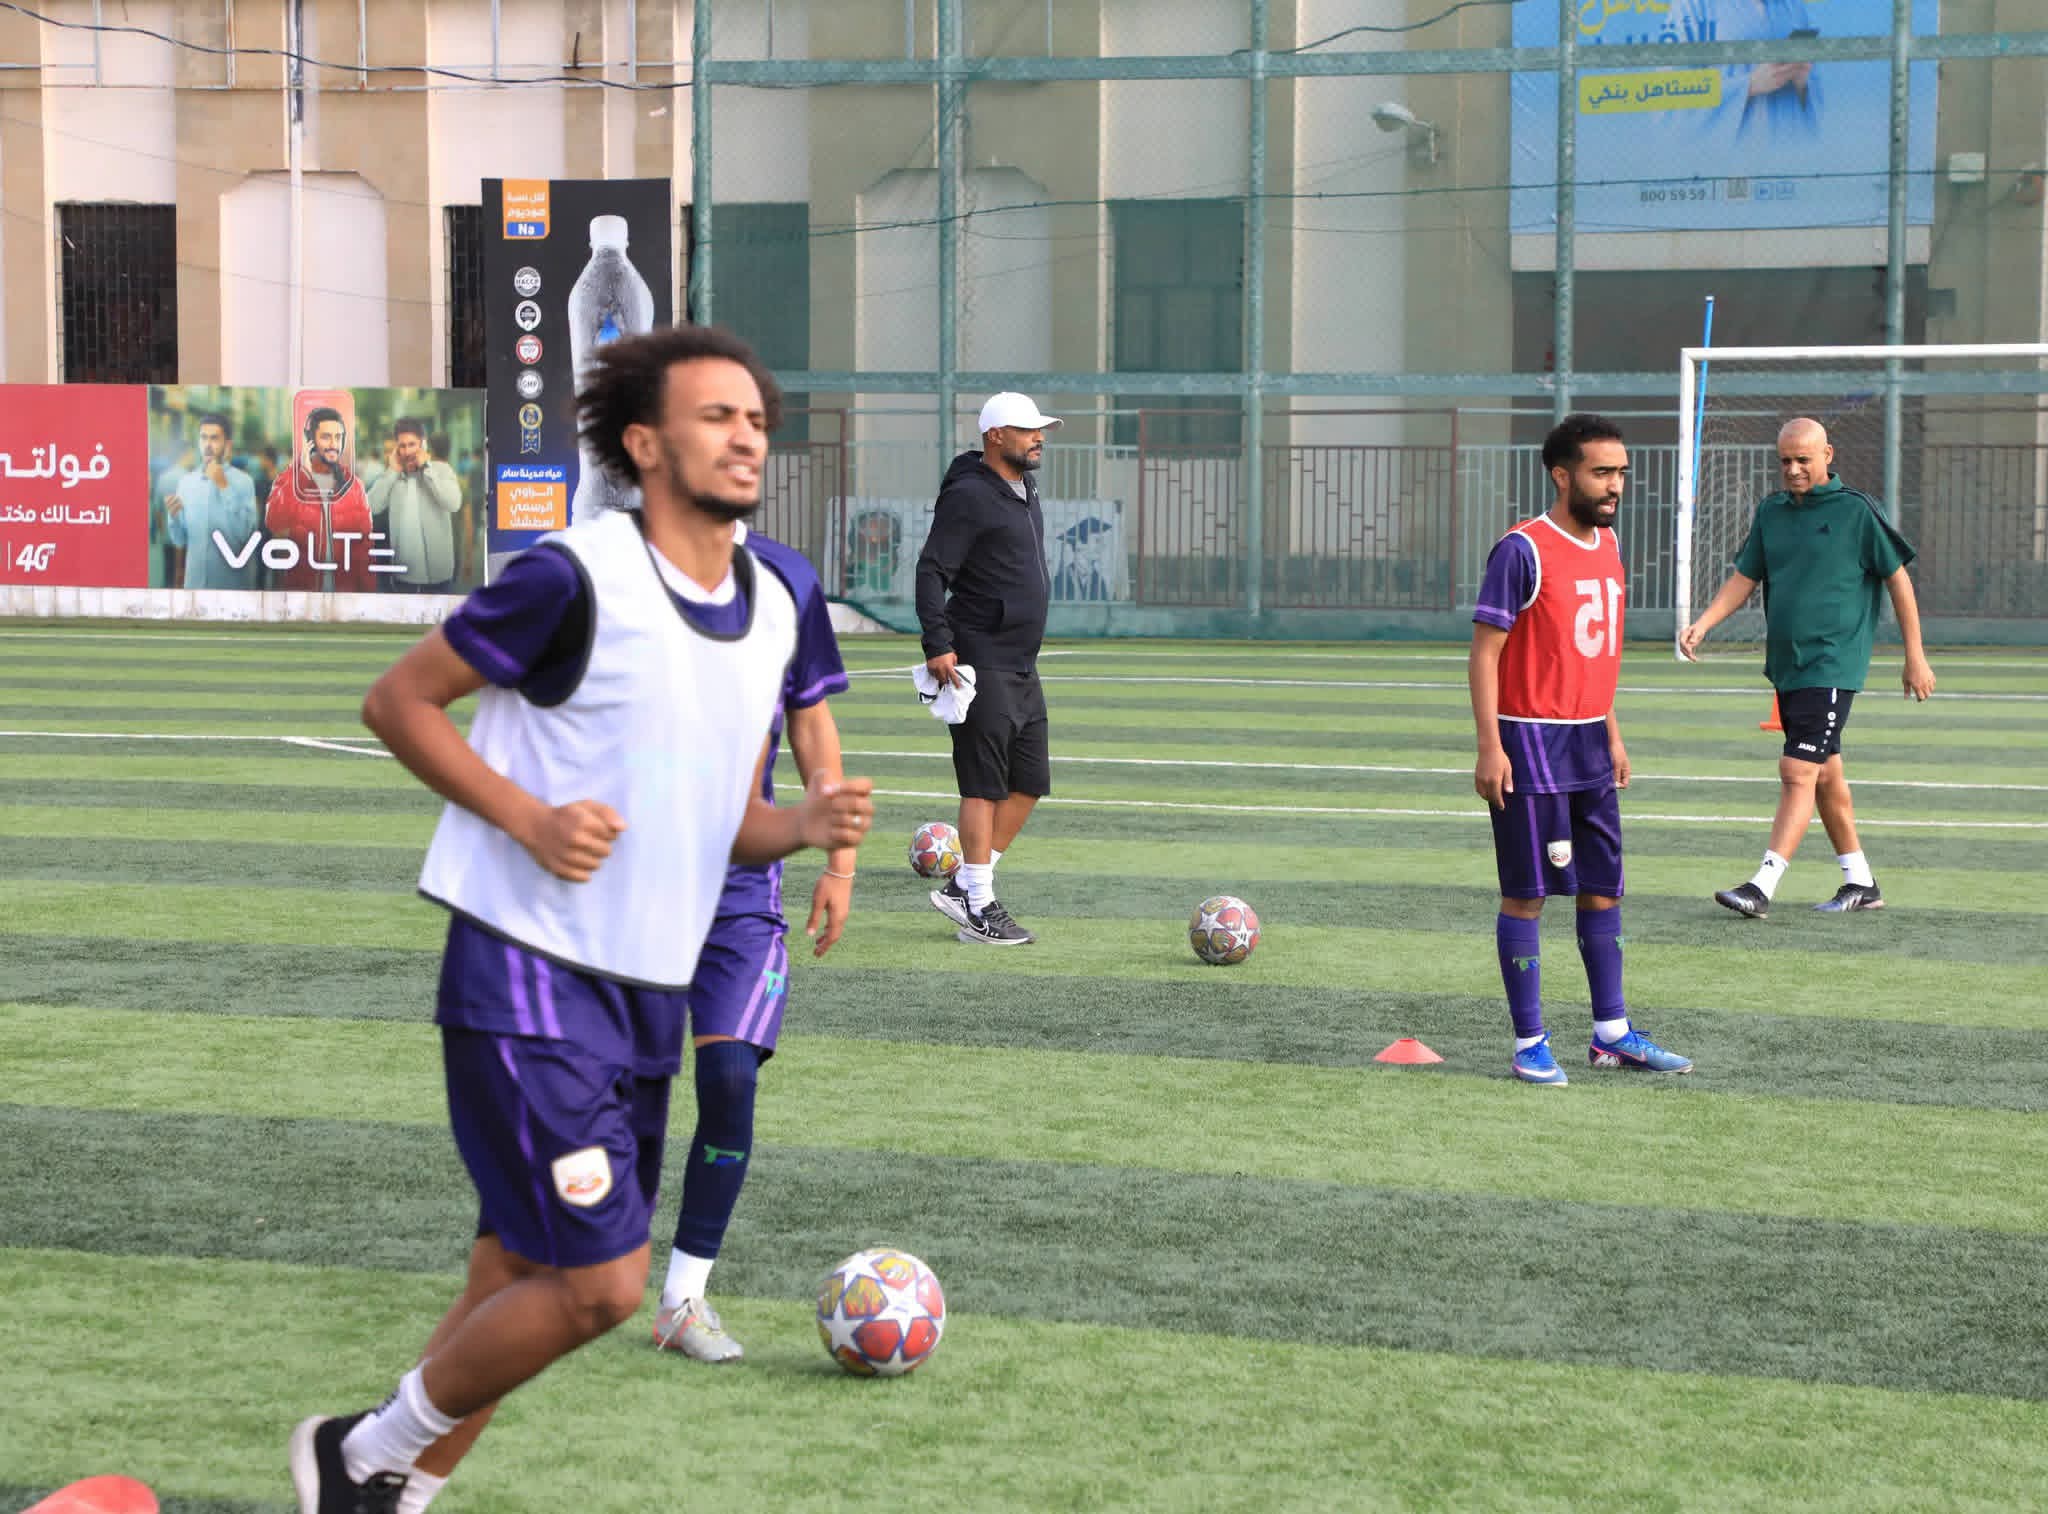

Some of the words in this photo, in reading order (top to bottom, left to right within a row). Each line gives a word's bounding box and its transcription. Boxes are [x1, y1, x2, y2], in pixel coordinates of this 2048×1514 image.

[1588, 83, 1629, 109] بنكي
[1635, 77, 1712, 103] تستاهل
[518, 223, 535, 236] Na
[0, 505, 37, 523] مخت
[41, 504, 110, 525] اتصالك
[16, 543, 56, 573] 4G
